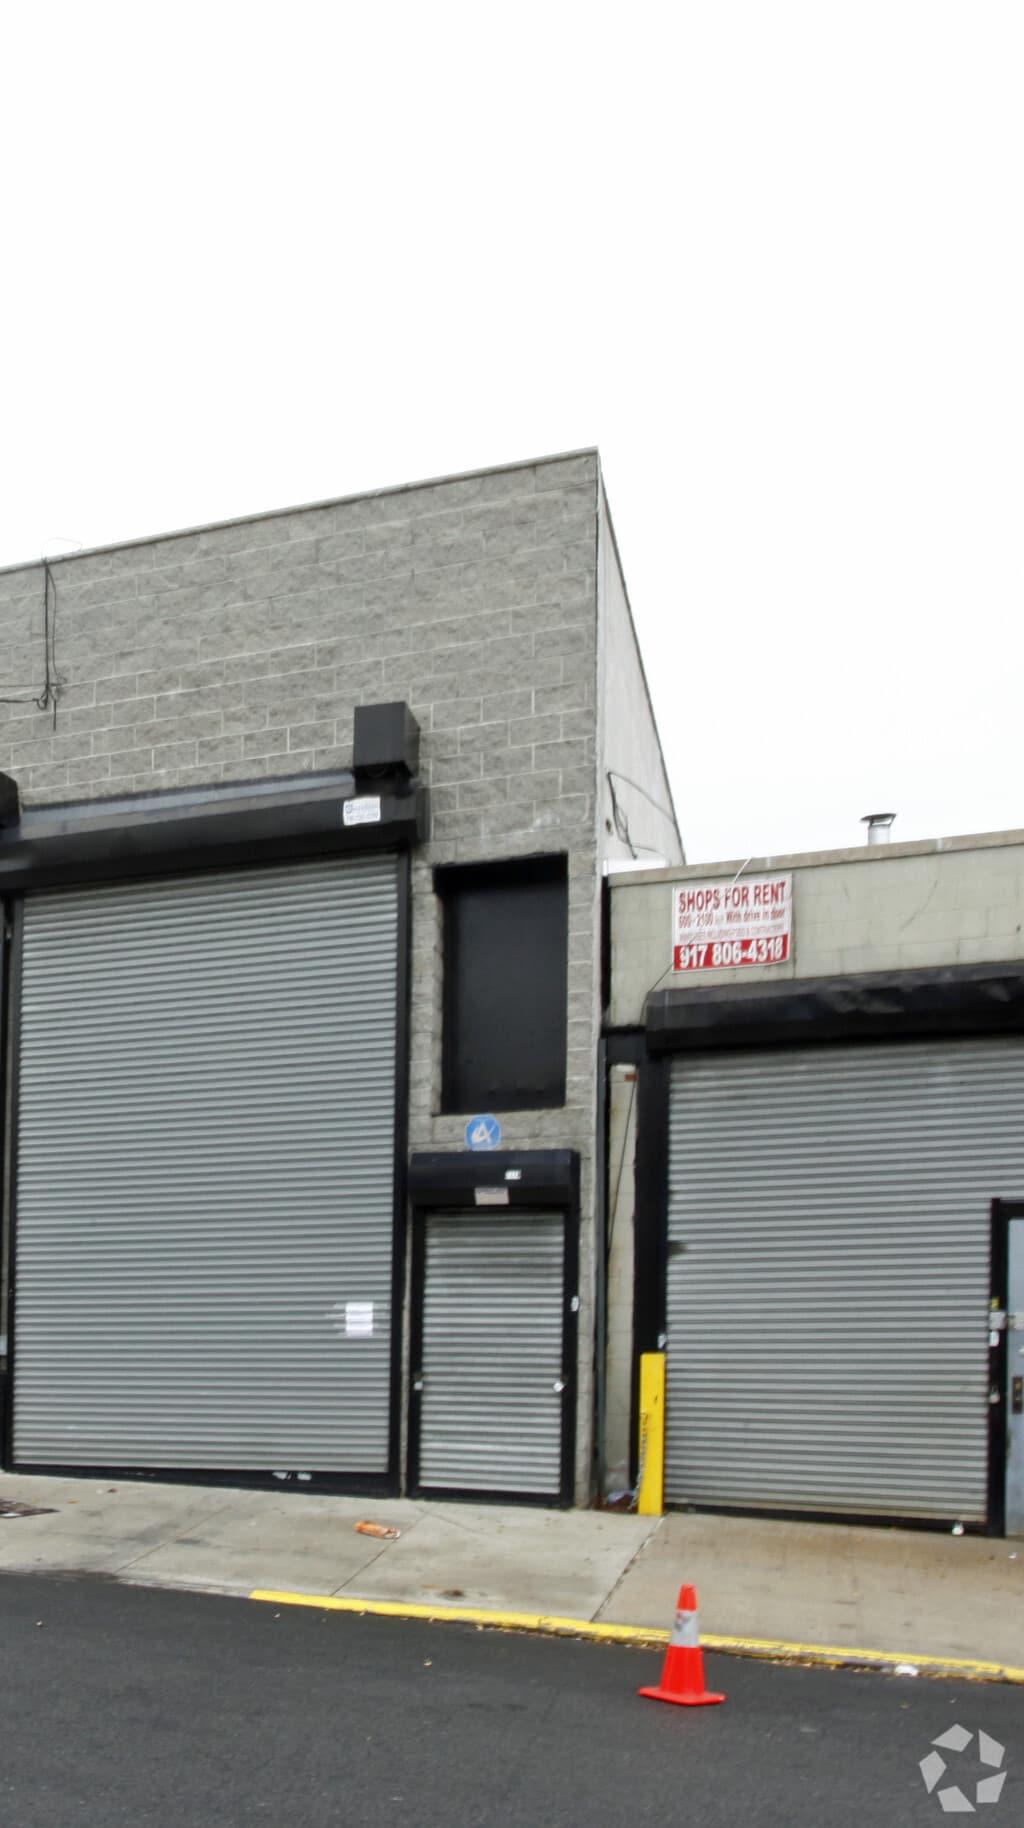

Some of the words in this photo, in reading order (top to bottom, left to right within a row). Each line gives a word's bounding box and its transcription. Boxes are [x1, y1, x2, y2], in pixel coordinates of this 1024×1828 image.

[679, 889, 721, 913] SHOPS
[724, 885, 749, 908] FOR
[754, 881, 786, 907] RENT
[680, 943, 708, 968] 917
[712, 937, 783, 965] 806-4318
